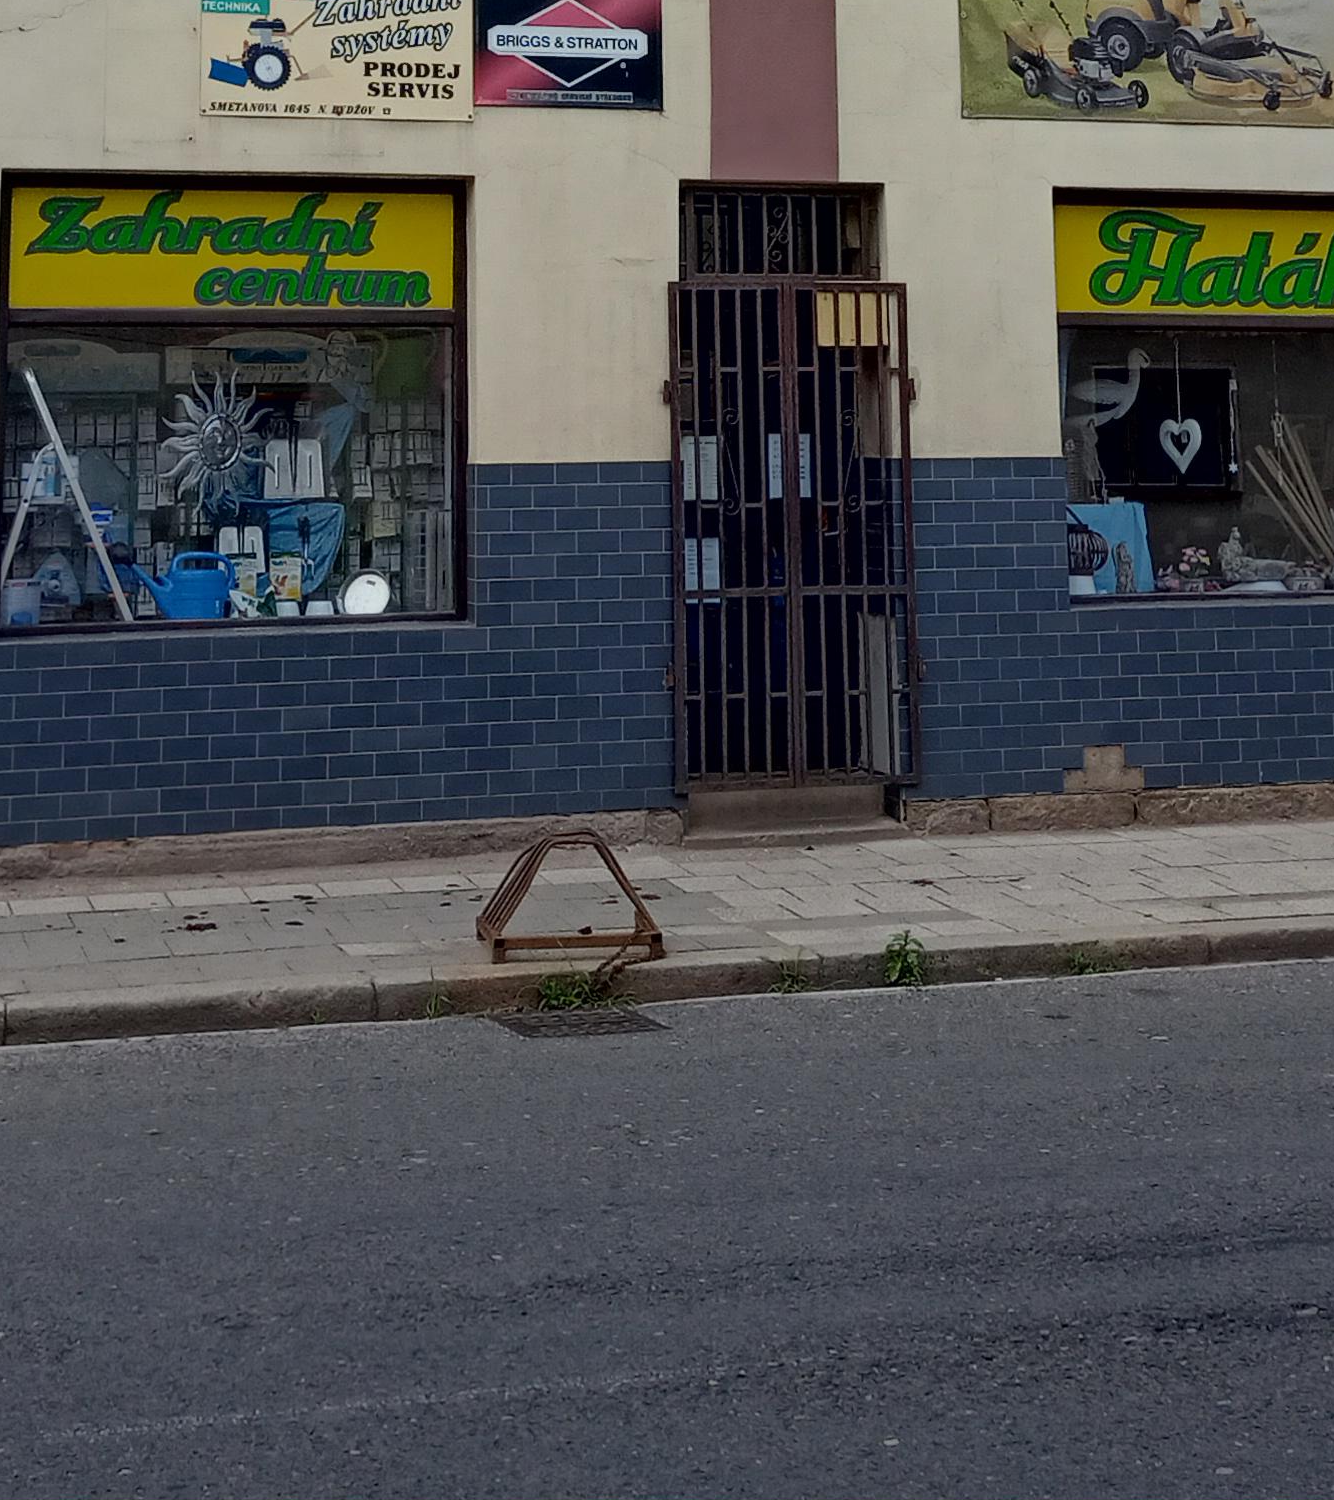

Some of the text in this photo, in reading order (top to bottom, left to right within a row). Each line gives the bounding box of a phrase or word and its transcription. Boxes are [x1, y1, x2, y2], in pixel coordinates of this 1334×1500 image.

[202, 0, 261, 13] TECHNIKA
[330, 19, 454, 63] systémy
[496, 34, 638, 50] BRIGGS & STRATTON
[363, 61, 461, 79] PRODEJ
[367, 82, 455, 100] SERVIS
[209, 101, 278, 113] SMETANOVA
[283, 103, 311, 114] 1645
[24, 188, 384, 256] Zahradní
[194, 252, 432, 308] centrum
